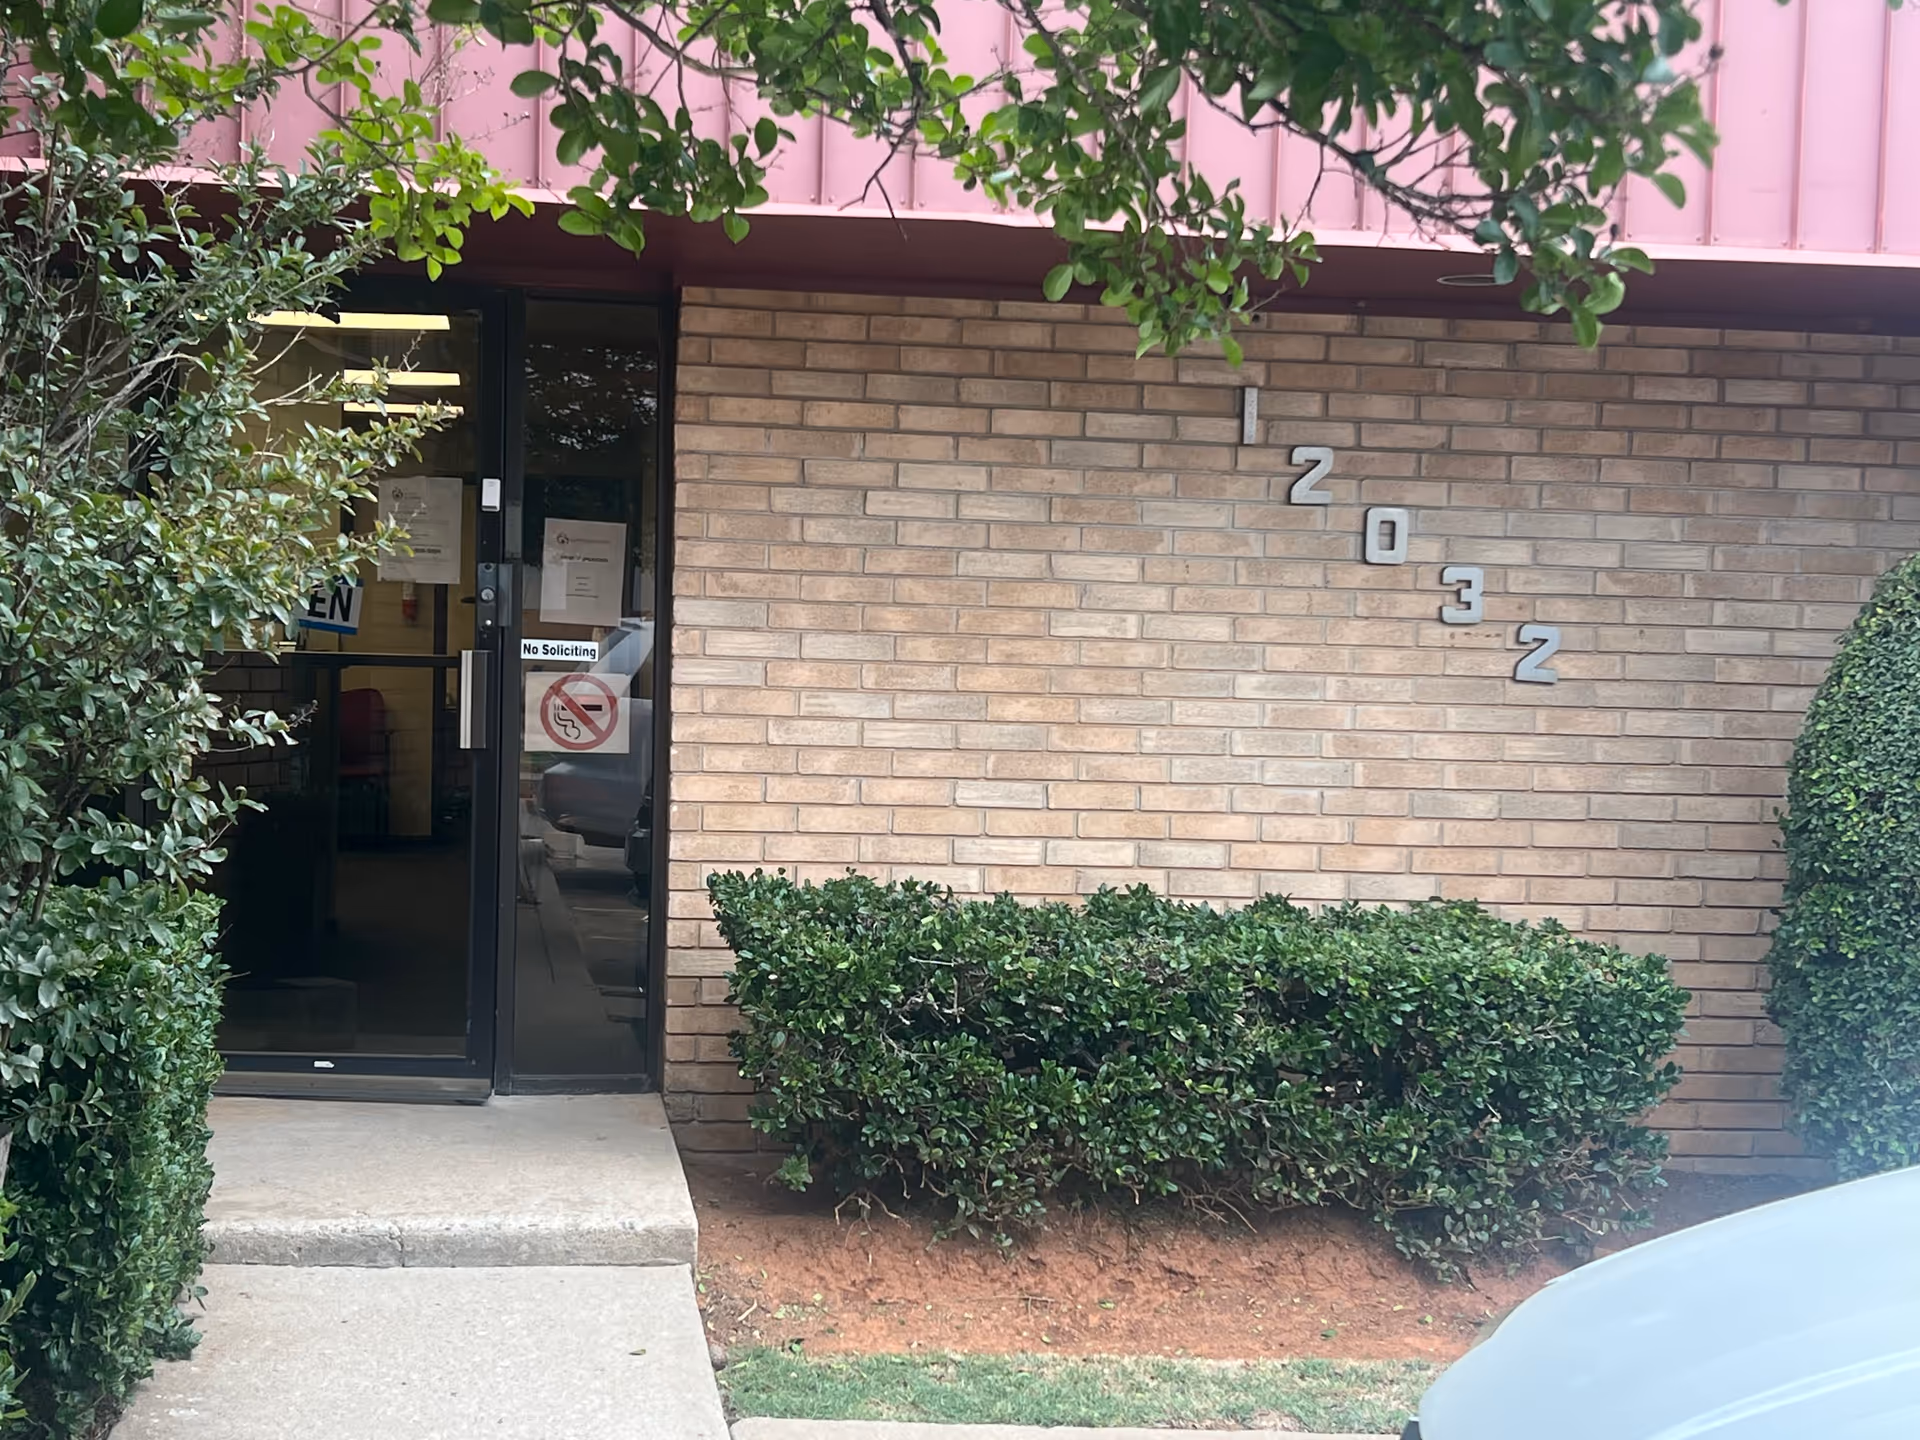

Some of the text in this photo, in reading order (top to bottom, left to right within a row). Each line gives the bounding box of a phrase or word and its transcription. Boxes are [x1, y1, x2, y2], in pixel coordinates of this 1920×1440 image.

[1242, 386, 1561, 684] 12032
[307, 584, 353, 622] EN
[523, 643, 596, 660] No Soliciting
